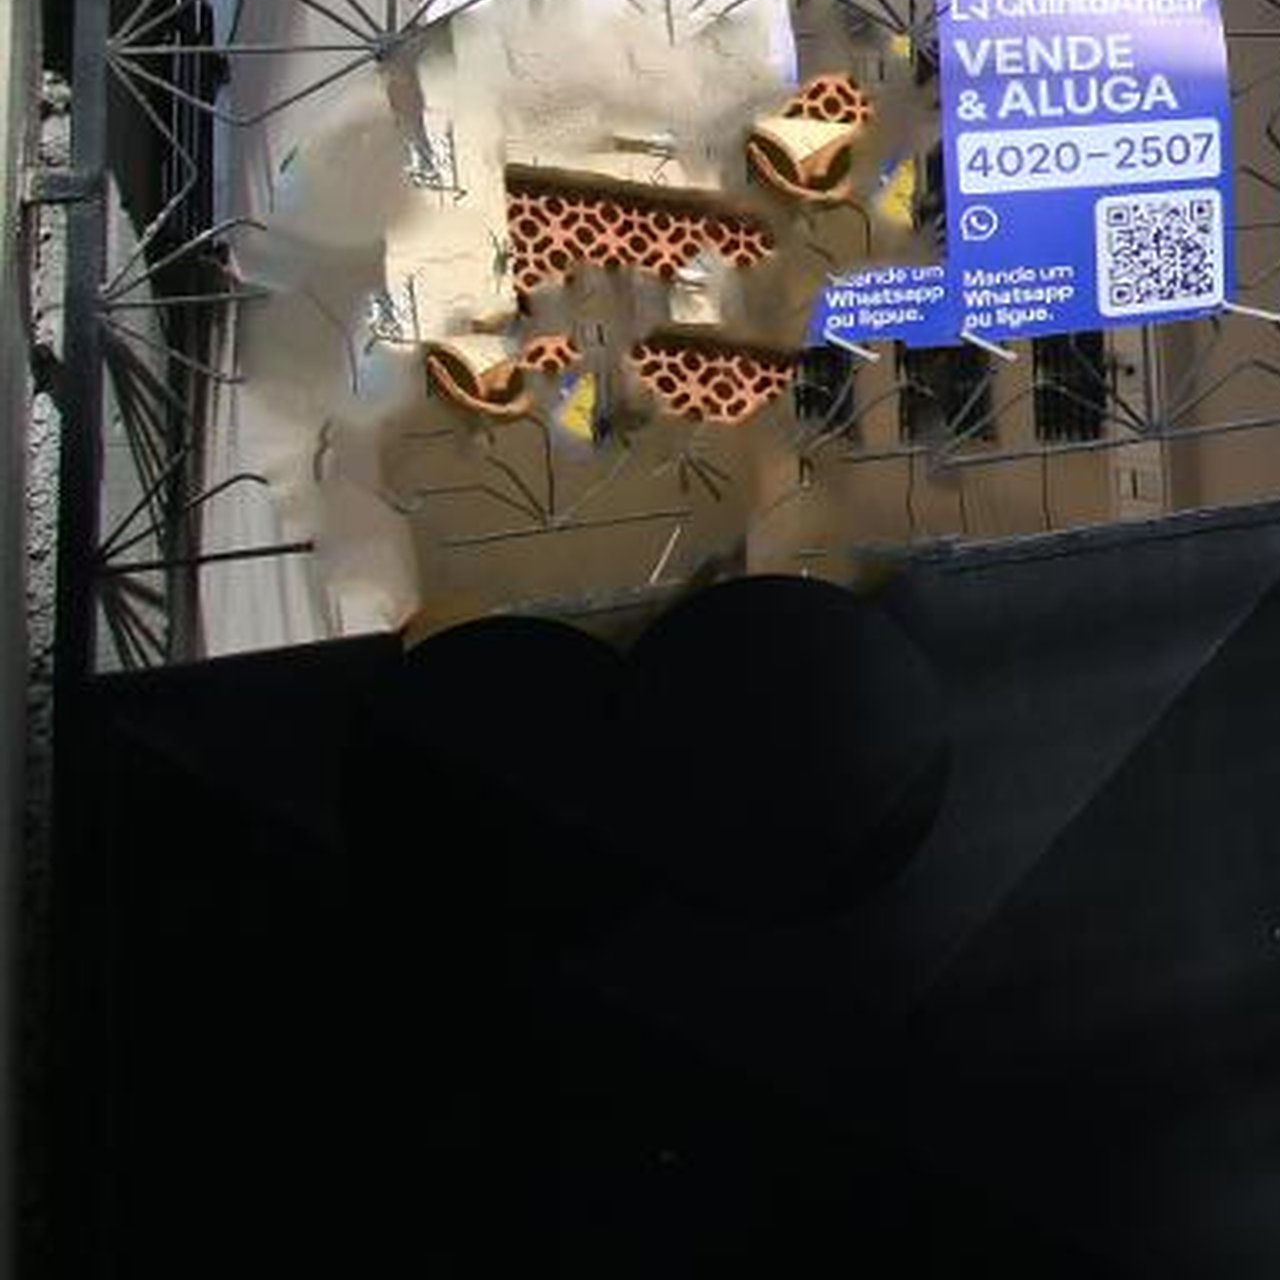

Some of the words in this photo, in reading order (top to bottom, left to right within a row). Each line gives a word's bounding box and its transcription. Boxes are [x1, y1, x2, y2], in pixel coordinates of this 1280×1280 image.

[953, 33, 1135, 78] VENDE
[956, 89, 987, 121] &
[997, 73, 1180, 119] ALUGA
[966, 133, 1214, 178] 4020-2507
[1041, 265, 1075, 280] um
[965, 313, 991, 329] ou
